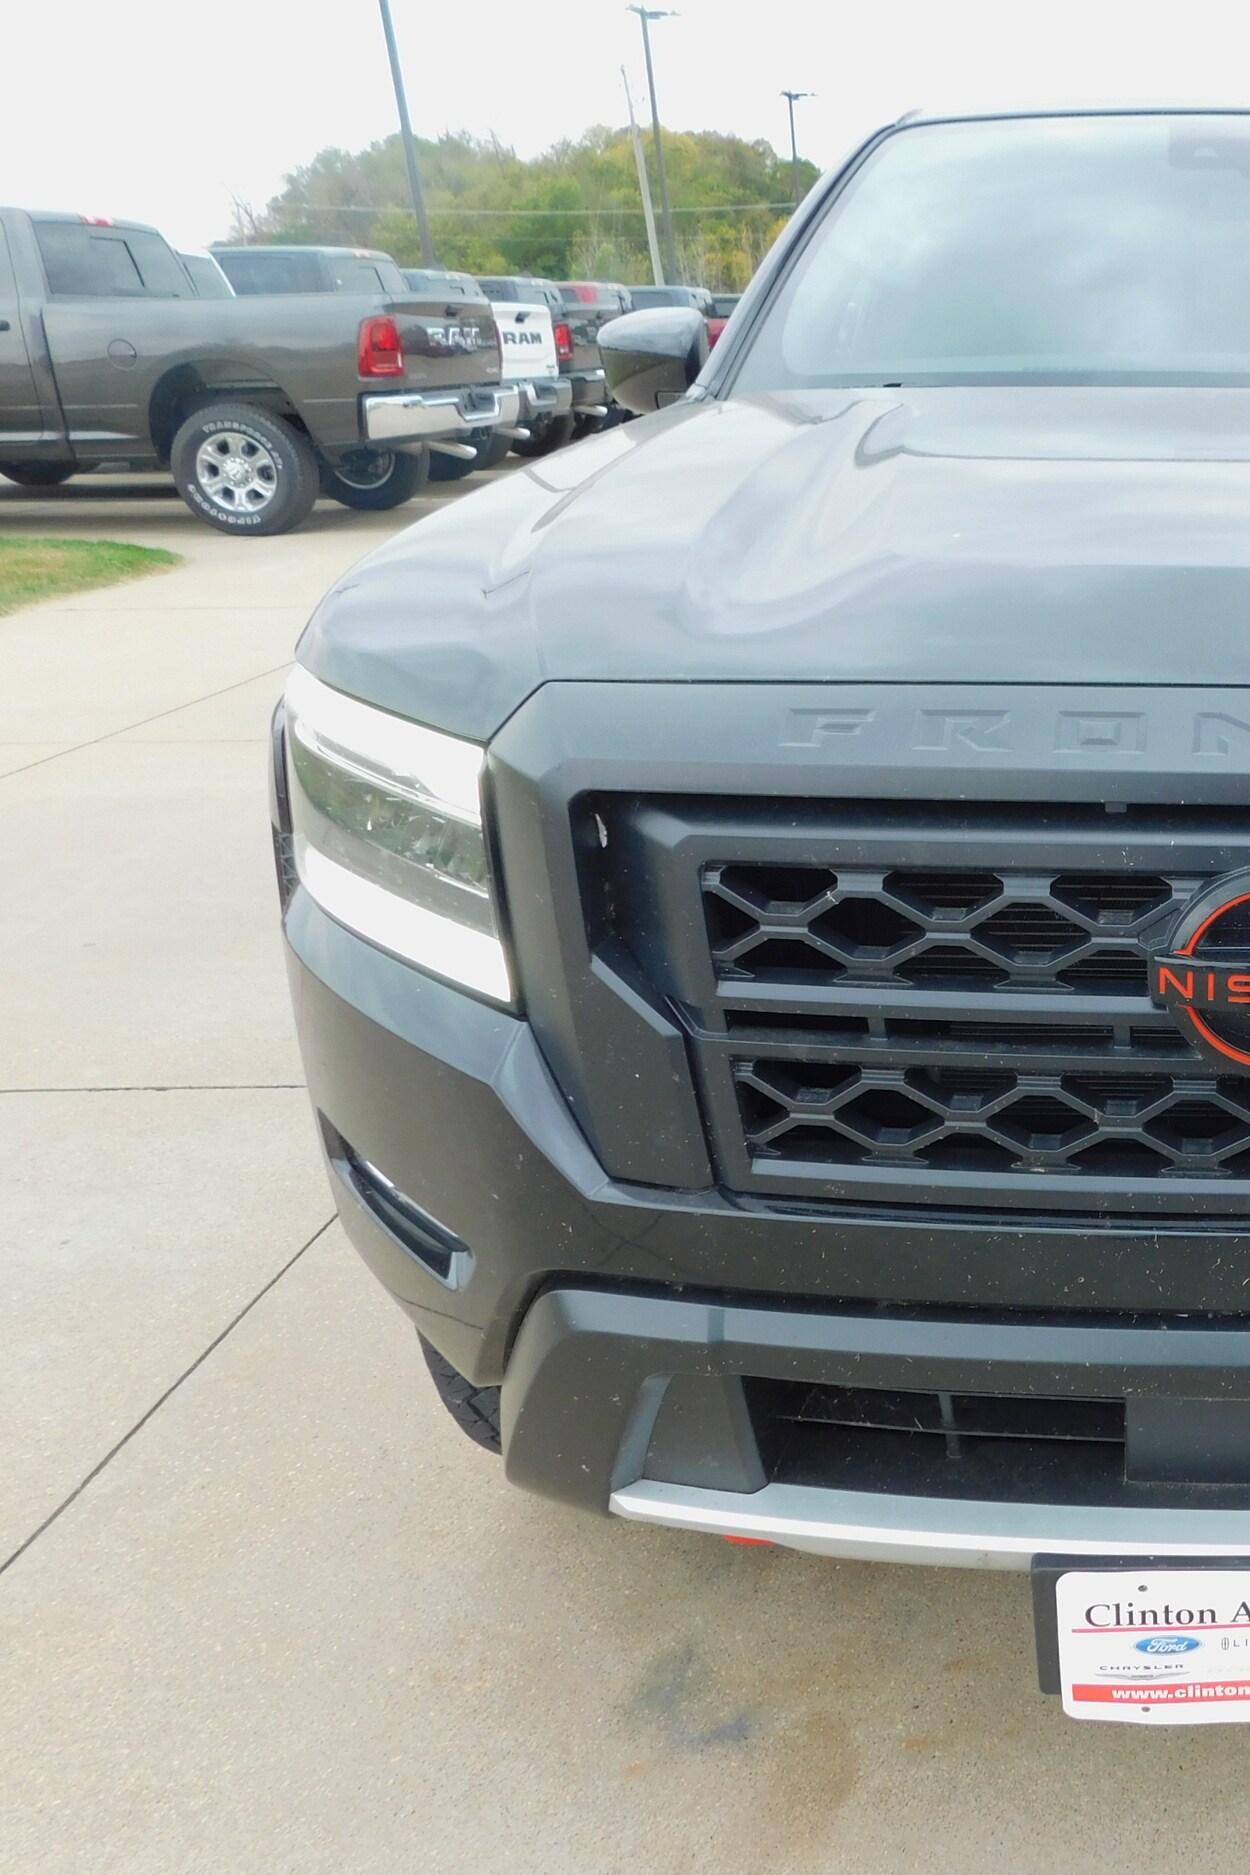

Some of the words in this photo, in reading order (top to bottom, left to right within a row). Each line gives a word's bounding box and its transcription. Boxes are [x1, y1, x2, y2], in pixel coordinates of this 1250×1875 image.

[503, 331, 543, 345] RAM
[1085, 1602, 1218, 1627] Clinton
[1146, 1638, 1189, 1653] Ford
